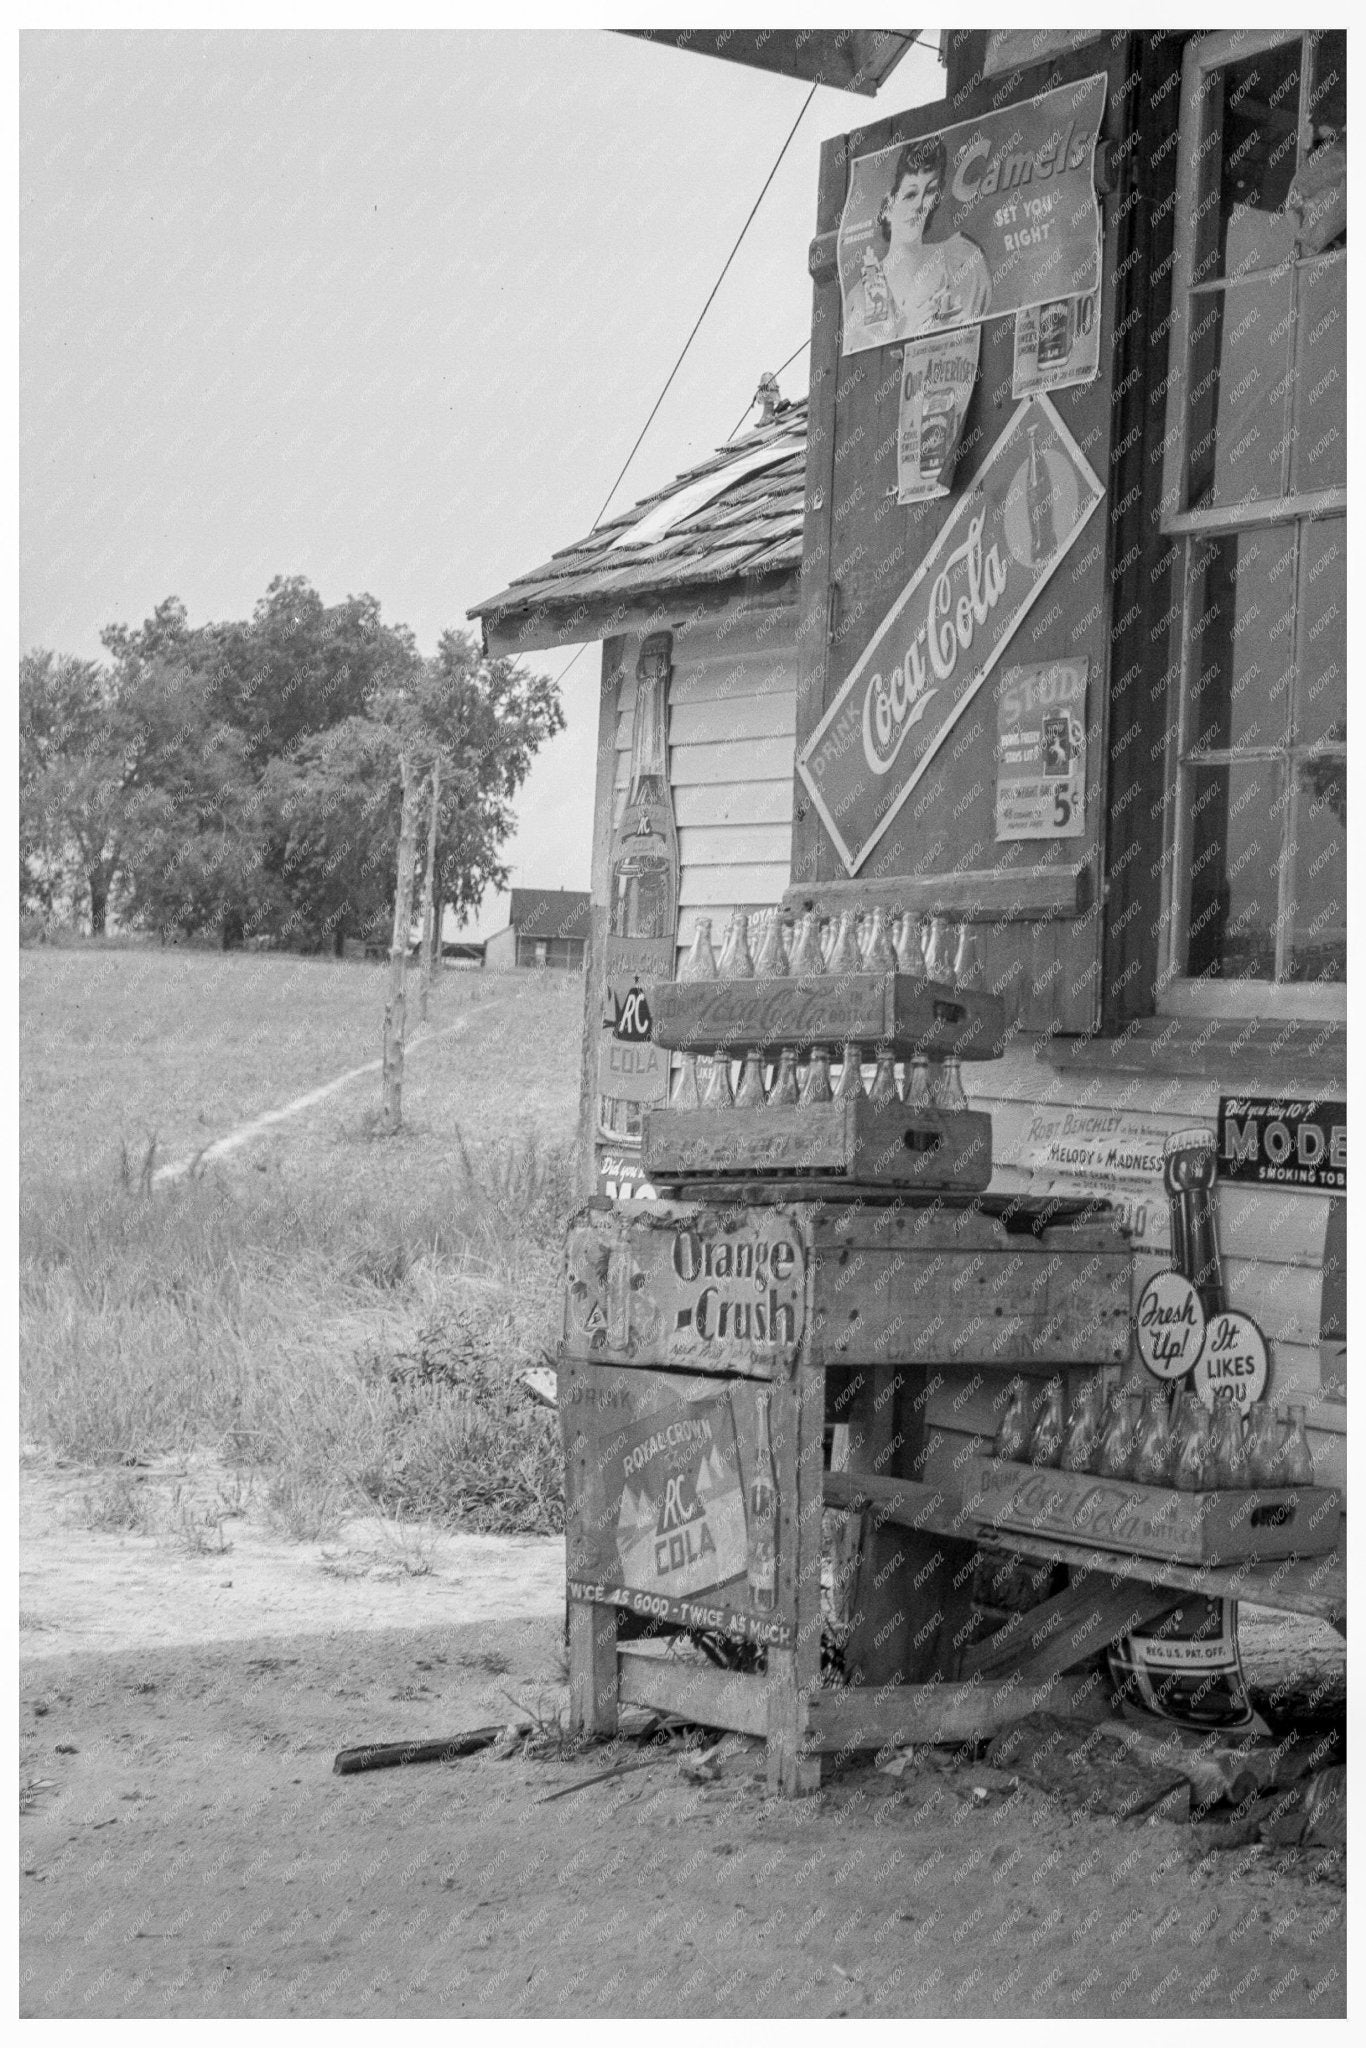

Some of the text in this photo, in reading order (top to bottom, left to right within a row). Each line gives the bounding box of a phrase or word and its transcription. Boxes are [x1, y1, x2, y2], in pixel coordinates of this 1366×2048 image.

[994, 195, 1052, 227] SET YOU
[619, 994, 648, 1034] RC
[1225, 1099, 1251, 1117] Did
[1248, 1105, 1267, 1120] you
[1267, 1106, 1286, 1121] say
[601, 1157, 624, 1177] Did
[620, 1165, 638, 1183] you
[1047, 1142, 1097, 1165] MELODY
[1104, 1147, 1164, 1172] MADNESS
[1259, 1166, 1316, 1183] SMOKING
[672, 1231, 795, 1293] Orange
[695, 1286, 795, 1344] Crush
[1141, 1290, 1198, 1328] Fresh
[1149, 1328, 1190, 1370] Up!
[1211, 1318, 1241, 1352] It
[1207, 1355, 1255, 1379] LIKES
[1212, 1383, 1247, 1402] YOU
[622, 1418, 713, 1478] ROYAL CROWN
[663, 1474, 694, 1529] RC
[655, 1521, 717, 1577] COLA
[608, 1588, 630, 1606] AS
[632, 1594, 670, 1616] GOOD
[679, 1602, 724, 1628] TWICE
[729, 1614, 746, 1634] AS
